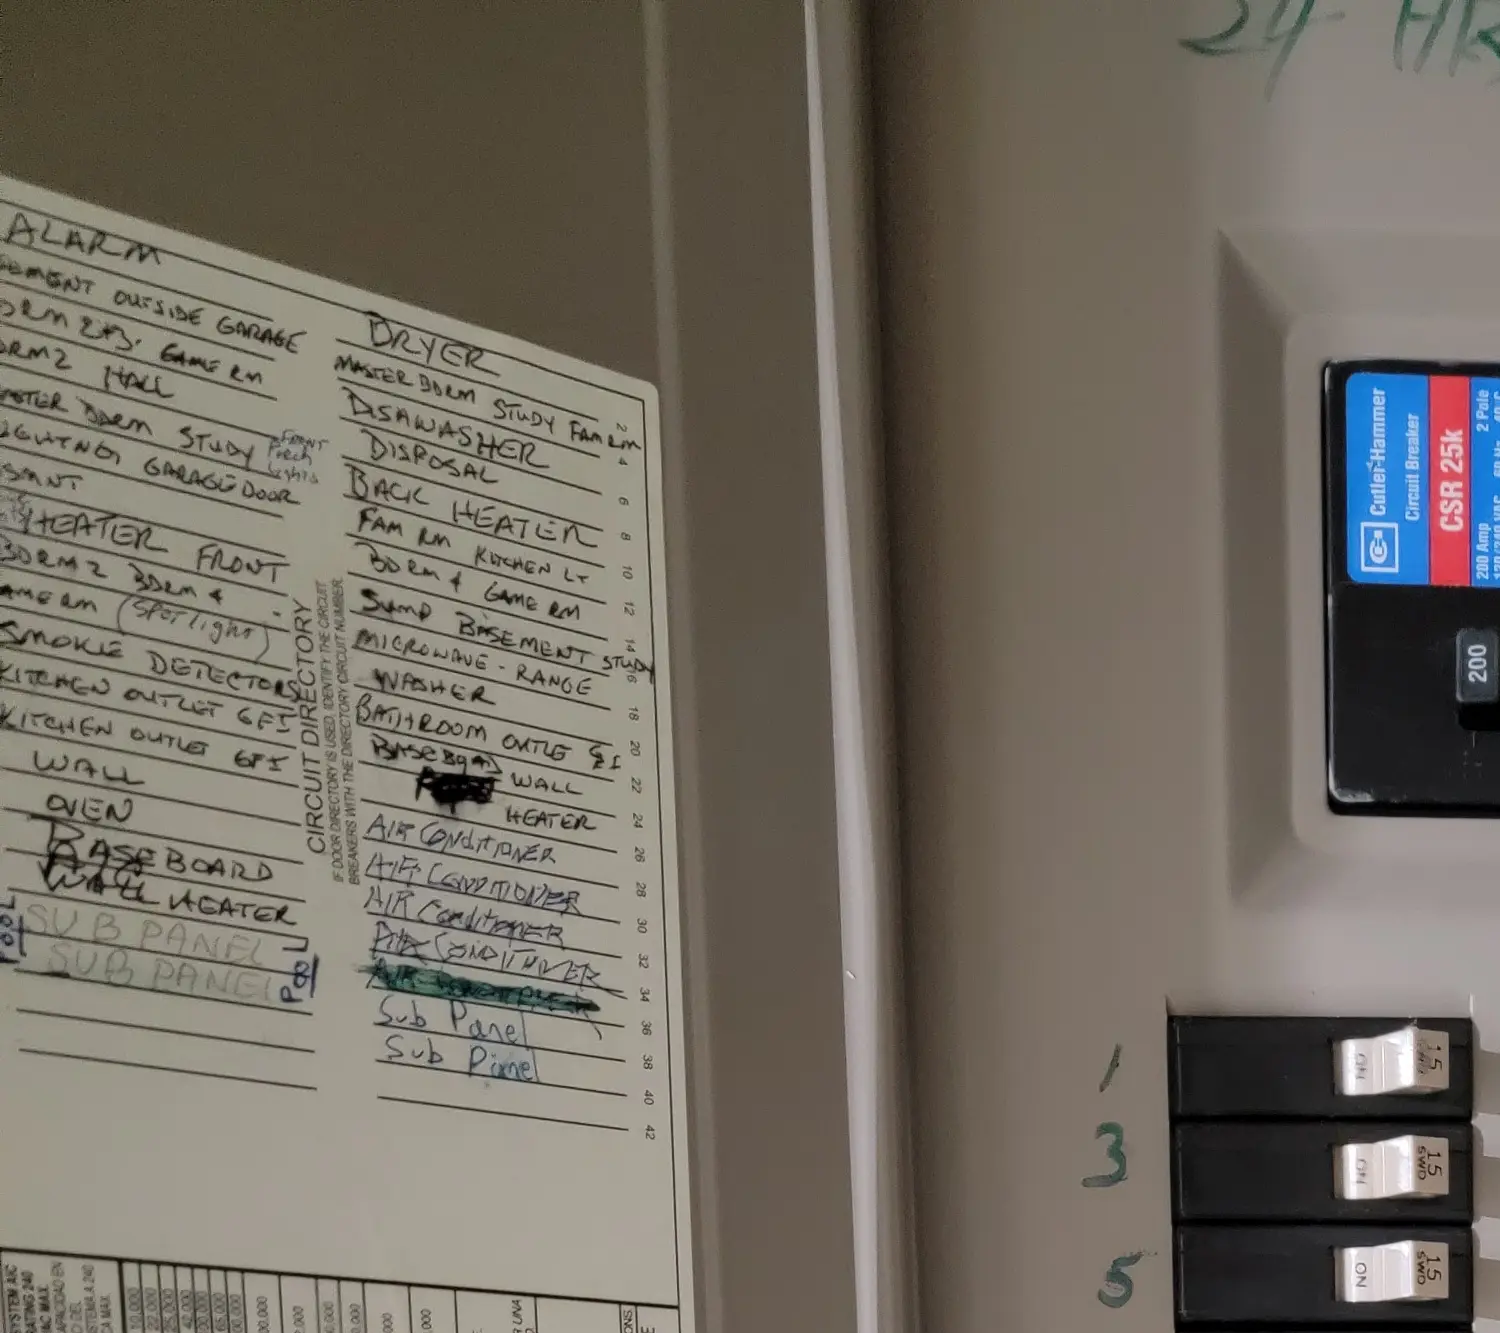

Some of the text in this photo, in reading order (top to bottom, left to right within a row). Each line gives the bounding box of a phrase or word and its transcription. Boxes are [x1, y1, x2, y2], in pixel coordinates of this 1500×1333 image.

[4, 212, 160, 264] ALARM
[114, 290, 307, 354] OUTSIDE GARAGE
[365, 311, 500, 376] DRYER
[160, 344, 262, 384] GAME RM
[335, 355, 413, 386] MASTER
[494, 399, 555, 434] STUDY
[569, 420, 602, 445] FAM
[1477, 390, 1489, 432] 2 Pole
[179, 426, 253, 469] STUDY
[362, 428, 499, 484] DISPOSAL
[1369, 387, 1386, 516] Cutler-Hammer
[1405, 413, 1420, 521] Circuit Breaker
[144, 457, 300, 504] GARAGE DOOR
[346, 462, 598, 548] BACK HEATER
[1440, 428, 1463, 532] CSR 25k
[36, 510, 290, 582] HEATER FRONT
[358, 507, 550, 574] FAM RM KITCHEN
[1477, 523, 1491, 579] 200 Amp
[549, 602, 579, 620] RM
[352, 628, 592, 695] MICROWAVE RANGE
[455, 611, 593, 664] BASEMENT
[1467, 644, 1487, 683] 200
[124, 688, 222, 716] OUTLET
[146, 650, 302, 702] DETECTORS
[371, 668, 496, 705] WASHER
[293, 600, 325, 854] CIRCUIT DIRECTORY
[356, 693, 487, 742] BATHROOM
[32, 750, 145, 784] WALL
[511, 773, 583, 795] WALL
[46, 794, 132, 823] OVEN
[506, 805, 596, 831] HEATER
[170, 889, 297, 925] HEATER
[27, 905, 264, 966] SUB PANEL
[1099, 1044, 1122, 1093] 1
[1081, 1122, 1128, 1188] 3
[1098, 1250, 1144, 1308] 5
[1355, 1262, 1367, 1289] ON
[1416, 1251, 1426, 1285] SWD
[1426, 1255, 1441, 1281] 15
